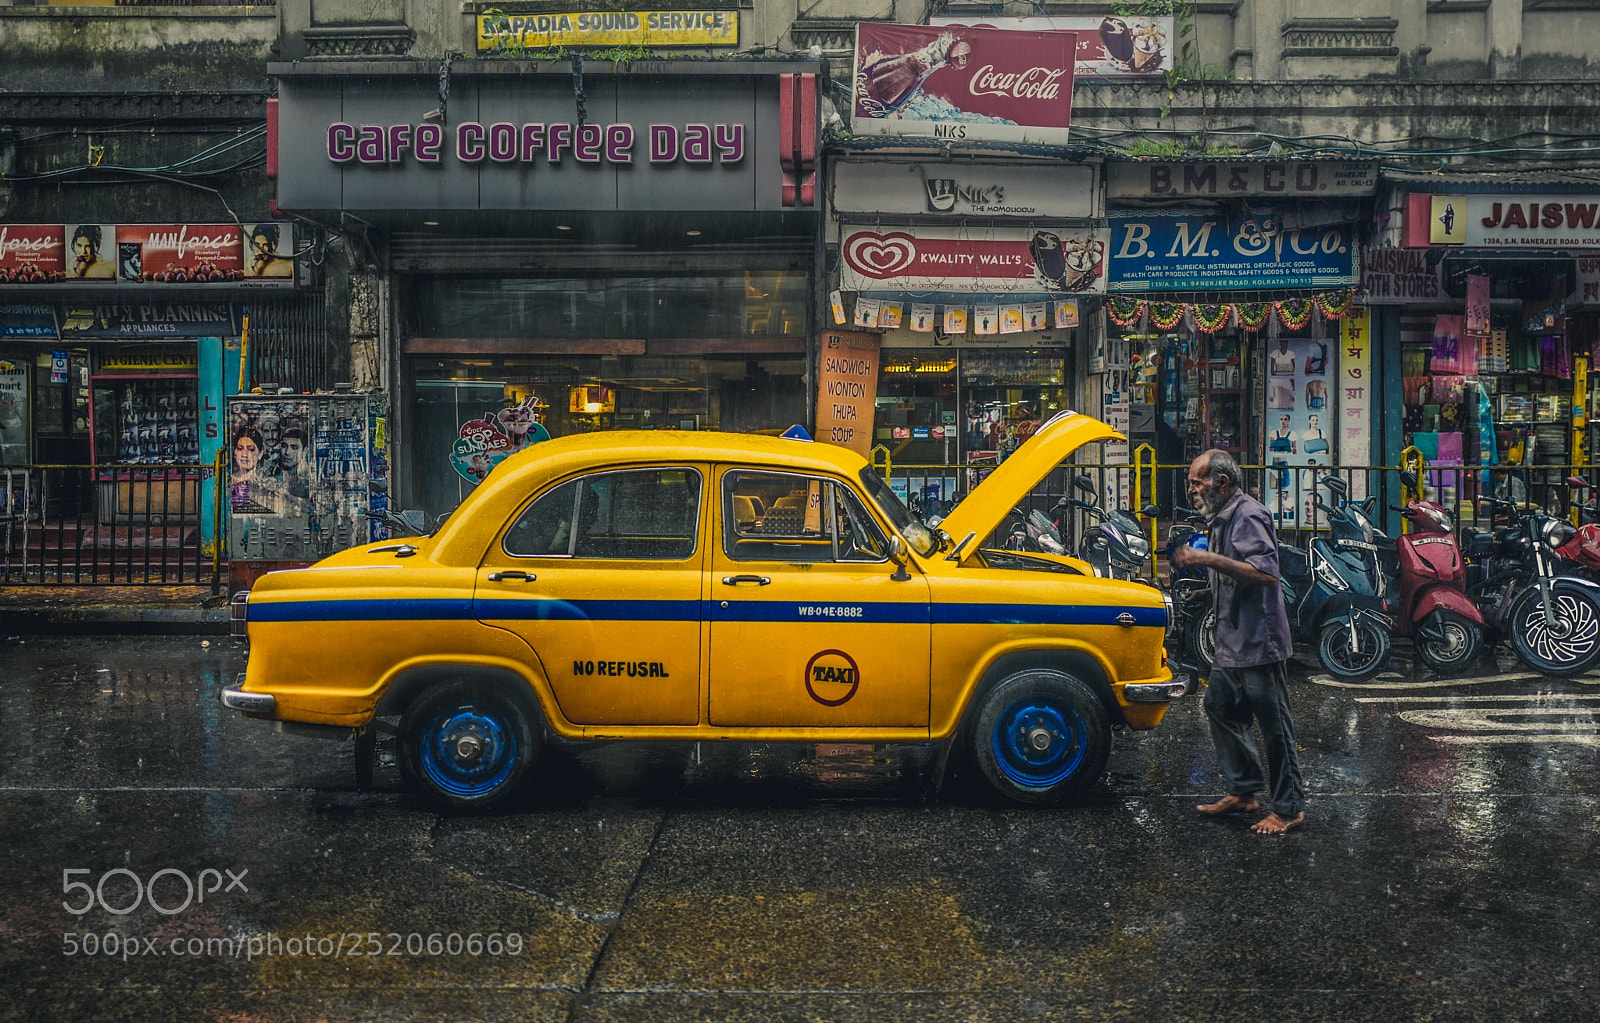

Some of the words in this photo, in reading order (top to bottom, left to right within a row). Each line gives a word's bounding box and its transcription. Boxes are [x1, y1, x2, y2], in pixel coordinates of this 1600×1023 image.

[578, 13, 640, 32] SOUND
[647, 12, 724, 31] SERVICE
[969, 64, 1066, 99] Coca-Cola
[934, 124, 966, 139] NIKS
[649, 122, 746, 164] Day
[1228, 166, 1248, 192] &
[1263, 164, 1328, 190] CO.
[1114, 223, 1155, 258] B.
[1165, 222, 1220, 258] M.
[1232, 220, 1280, 257] &
[920, 253, 974, 264] KWALITY
[980, 254, 1022, 265] WALL'S
[1368, 250, 1424, 274] JAISWAL
[1393, 275, 1438, 298] STORES
[102, 354, 162, 366] HYGIENIC
[826, 358, 871, 376] SANDWICH
[827, 380, 866, 398] WONTON
[832, 404, 857, 420] THUPA
[462, 429, 493, 448] TOP
[831, 426, 854, 443] SOUP
[458, 438, 508, 454] SUNDAES
[573, 661, 594, 676] NO
[598, 661, 669, 677] REFUSAL
[813, 666, 854, 684] TAXI
